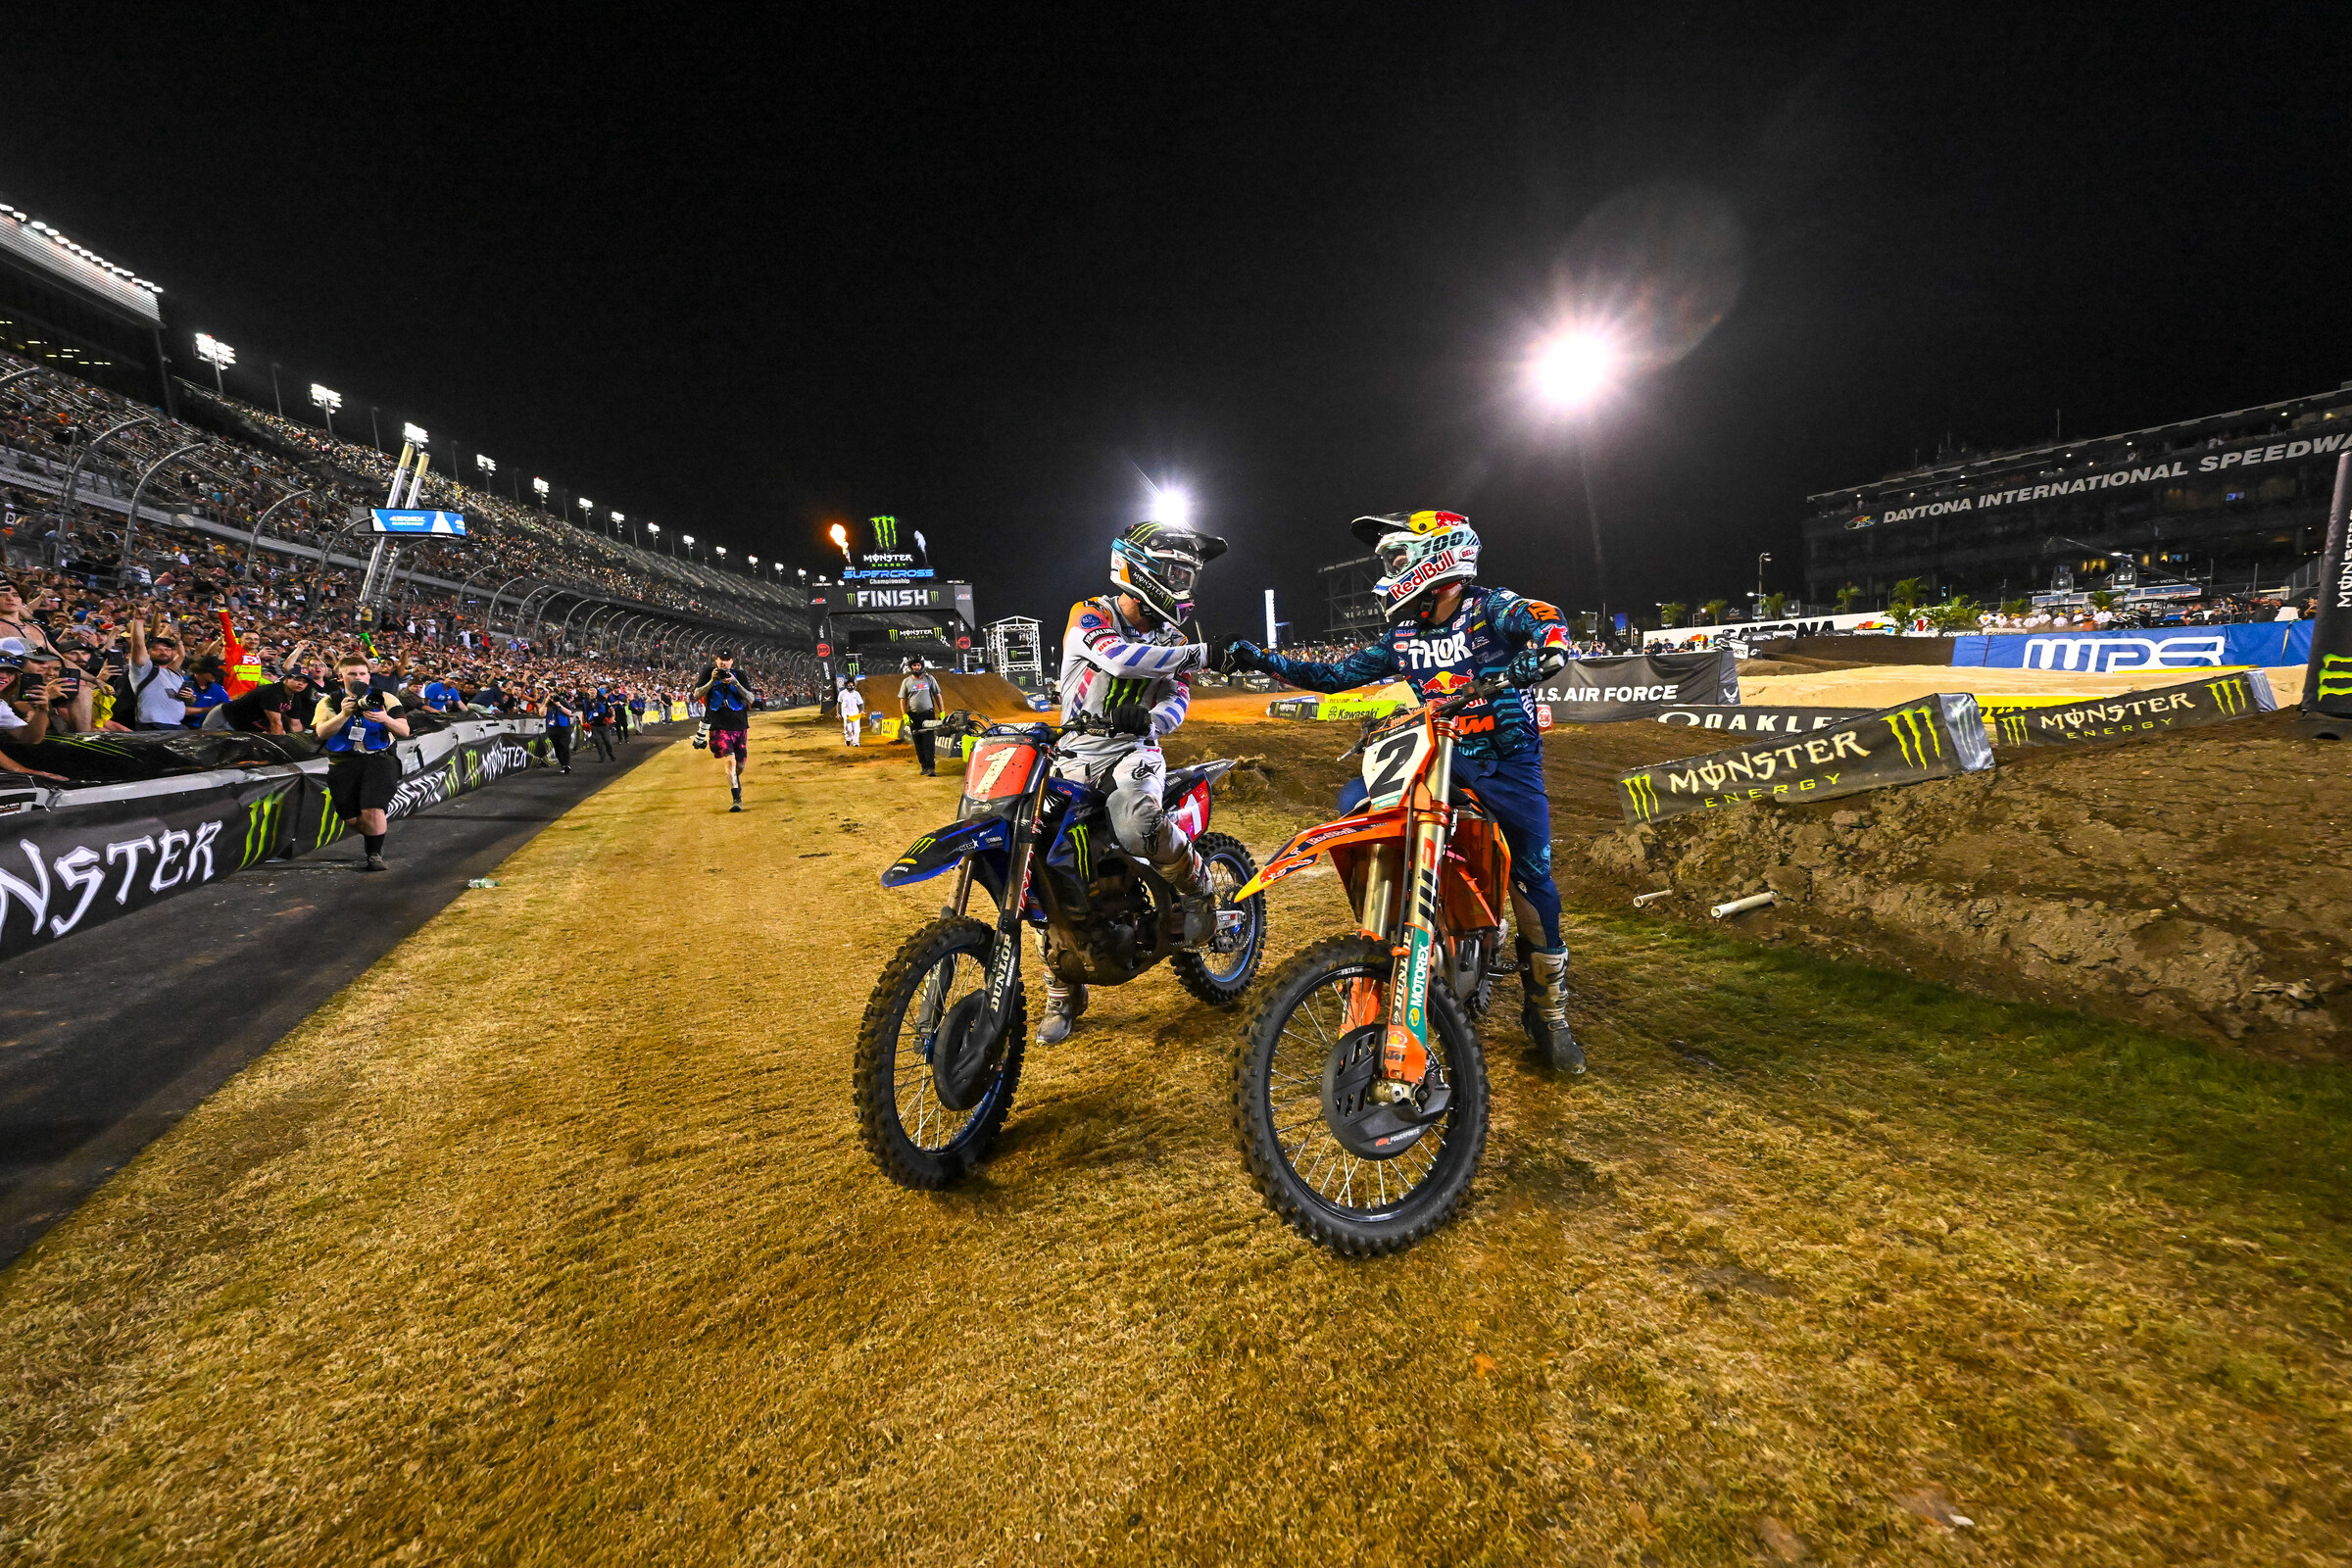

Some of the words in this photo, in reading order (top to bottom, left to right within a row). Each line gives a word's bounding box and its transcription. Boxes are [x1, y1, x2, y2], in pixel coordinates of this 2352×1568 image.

[1883, 498, 1972, 523] DAYTONA
[1978, 462, 2188, 509] INTERNATIONAL
[863, 554, 913, 563] MONSTER
[1461, 549, 1474, 558] BELL
[843, 568, 934, 579] SUPERCROSS
[1133, 571, 1164, 598] MONSTER
[857, 589, 929, 608] FINISH
[1723, 620, 1836, 638] AYTONA
[1098, 638, 1117, 653] BELL
[1408, 631, 1473, 670] THOR
[1564, 687, 1598, 702] AIR
[1603, 684, 1679, 701] FORCE
[1339, 708, 1380, 720] Kawasaki
[1704, 714, 1850, 733] OAKLE
[2040, 692, 2195, 730] MONSTER
[1457, 714, 1495, 735] TM
[2067, 717, 2174, 740] ENERGY
[973, 747, 1018, 795] 1
[1203, 762, 1227, 772] DUNLOP
[1369, 732, 1418, 800] 2
[1668, 730, 1871, 795] MONSTER
[1704, 772, 1840, 808] ENERGY
[1185, 794, 1202, 836] 1
[990, 934, 1012, 1012] DUNLOP
[1393, 931, 1411, 1010] DUNLP
[1410, 941, 1430, 1007] MOTOREX
